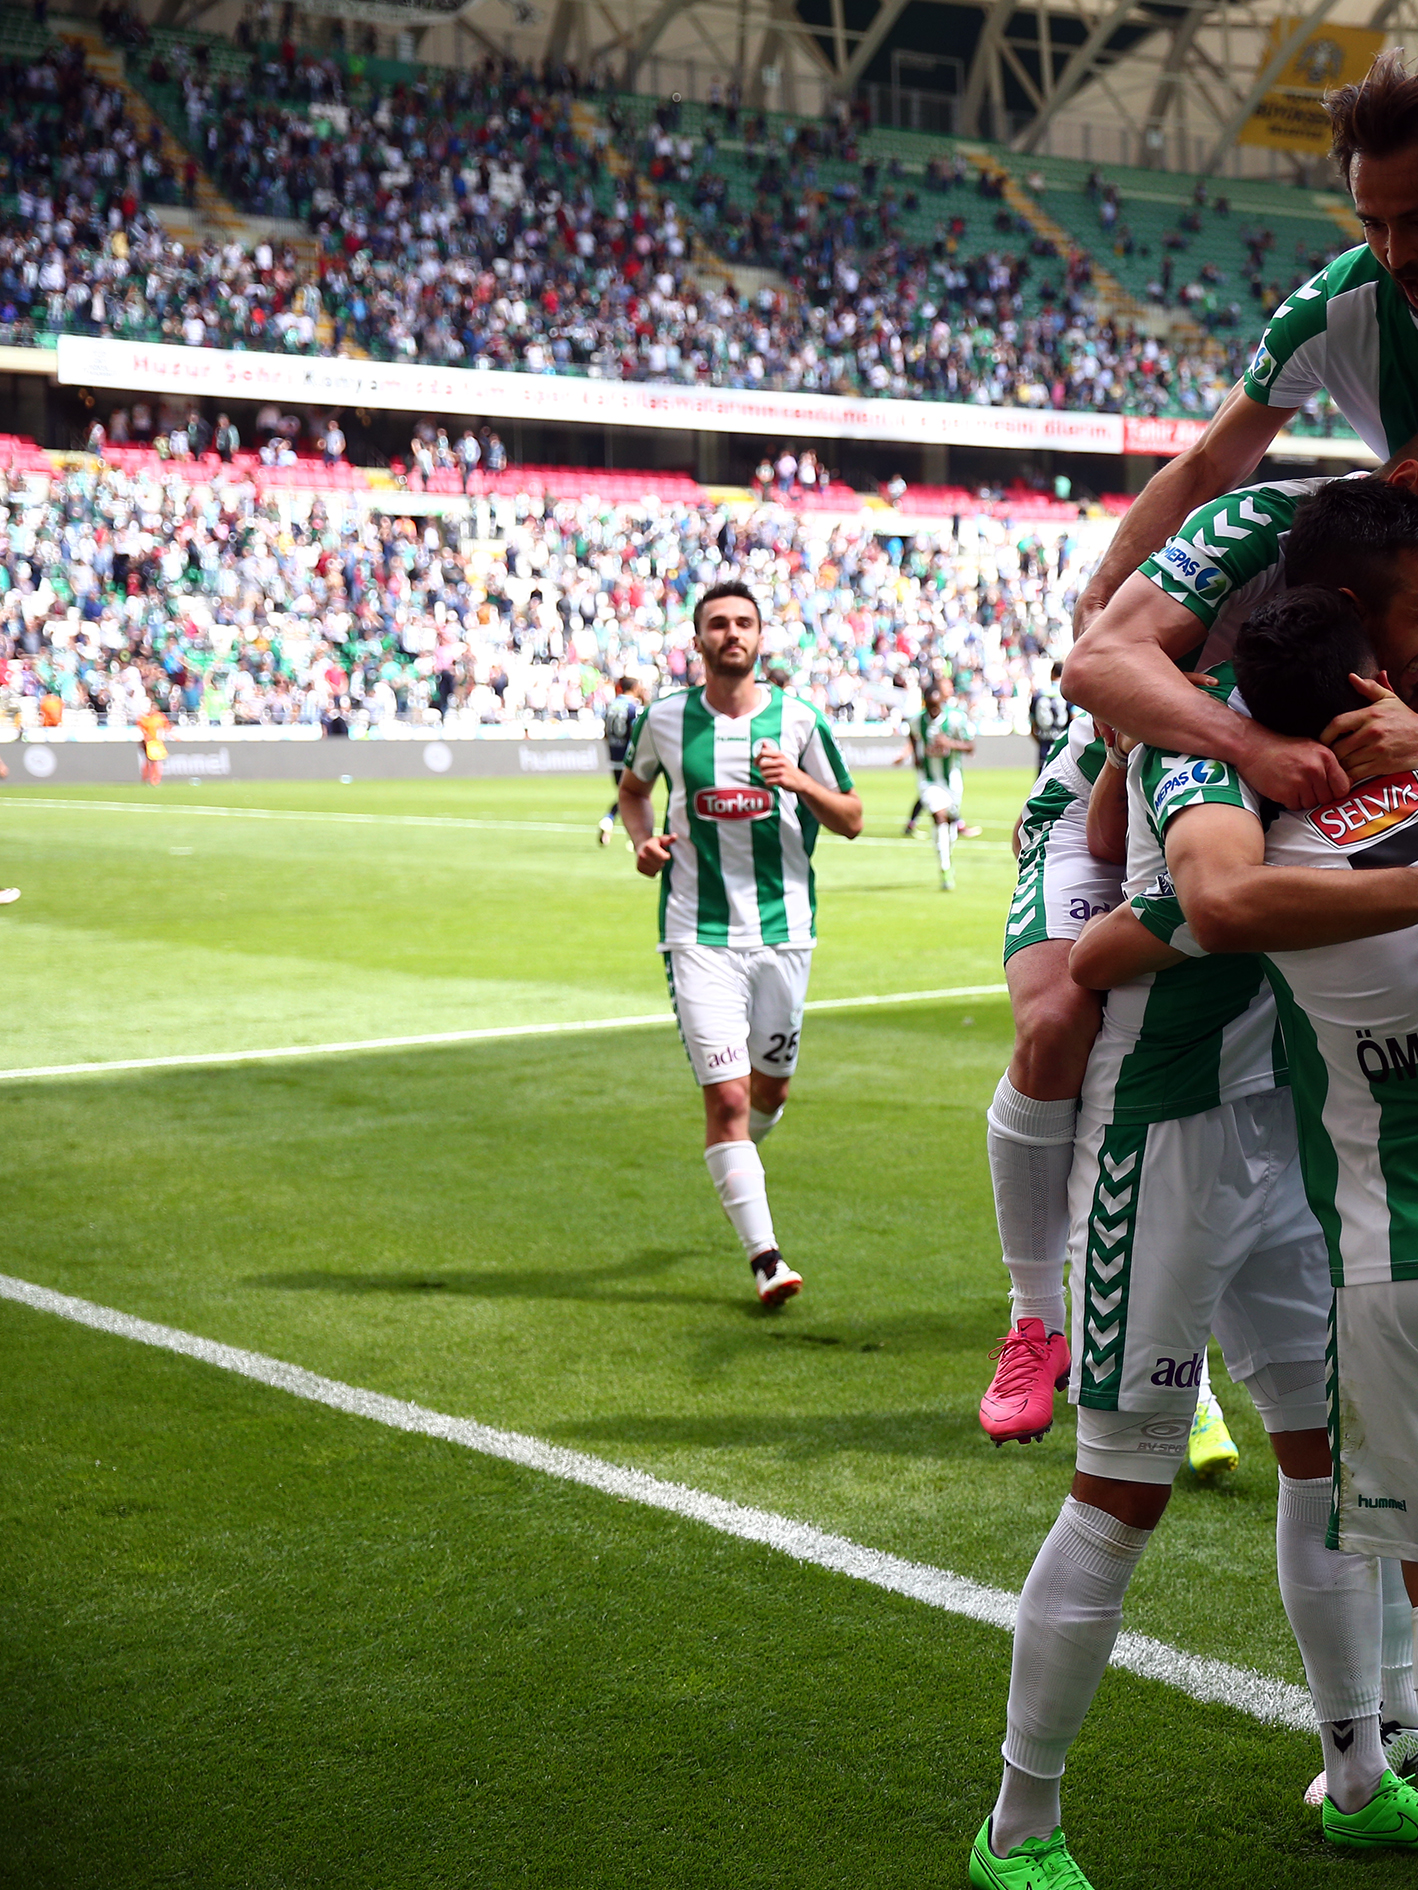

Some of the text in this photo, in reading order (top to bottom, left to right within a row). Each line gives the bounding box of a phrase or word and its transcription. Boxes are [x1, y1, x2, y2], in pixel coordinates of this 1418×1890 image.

[1161, 544, 1201, 578] MEPAŞ
[518, 744, 599, 771] hummel
[702, 792, 764, 814] Torku
[1154, 771, 1190, 811] MEPAŞ
[1358, 1494, 1407, 1512] hummel
